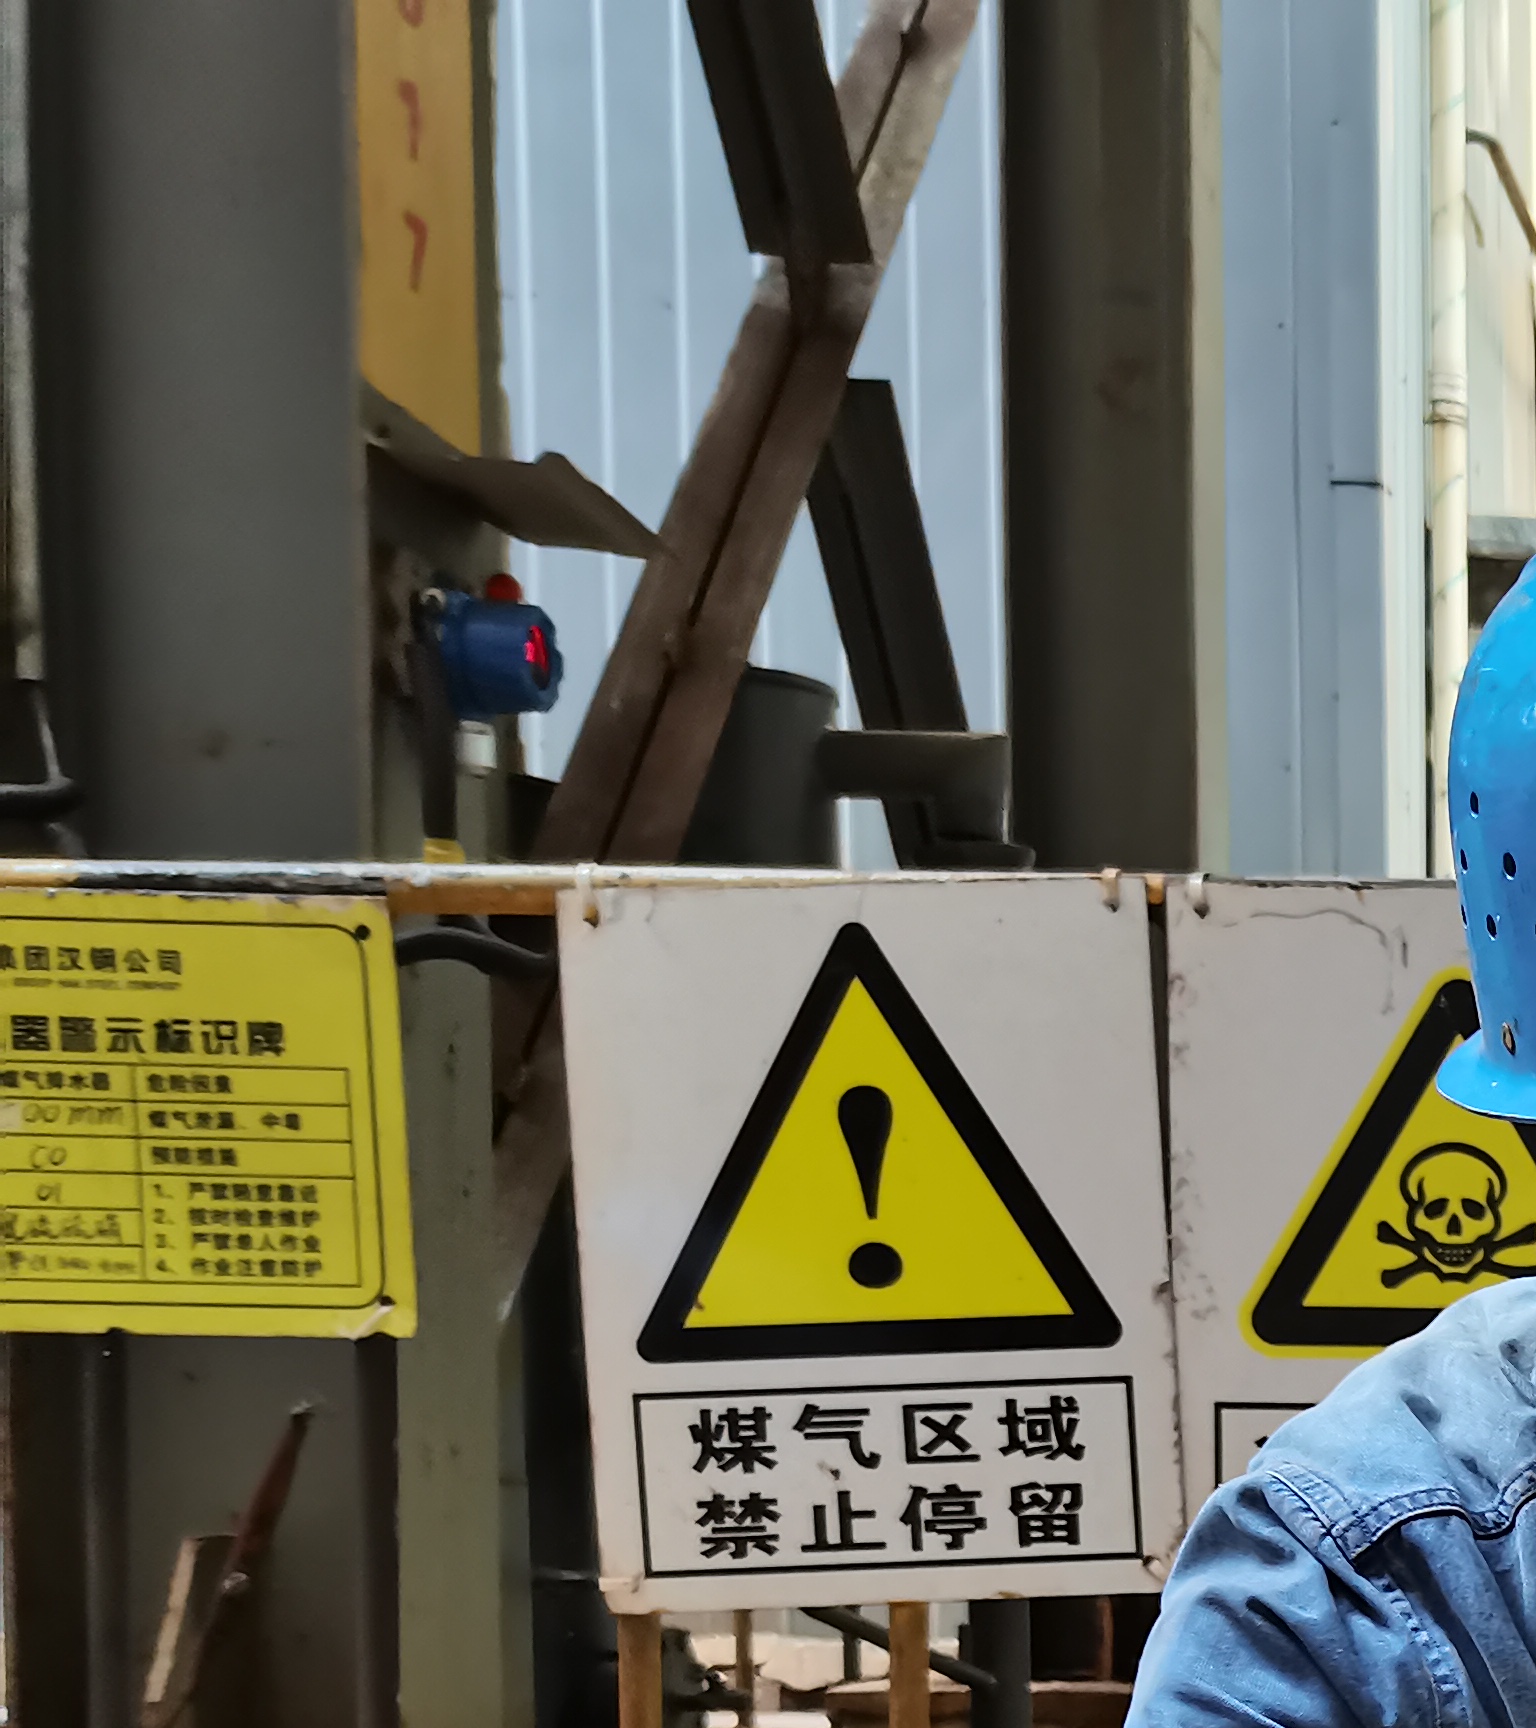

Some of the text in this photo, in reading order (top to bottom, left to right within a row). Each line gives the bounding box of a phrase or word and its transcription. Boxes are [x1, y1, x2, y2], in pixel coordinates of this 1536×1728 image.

[688, 1395, 1086, 1475] 煤气区域
[695, 1480, 1084, 1560] 禁止停留
